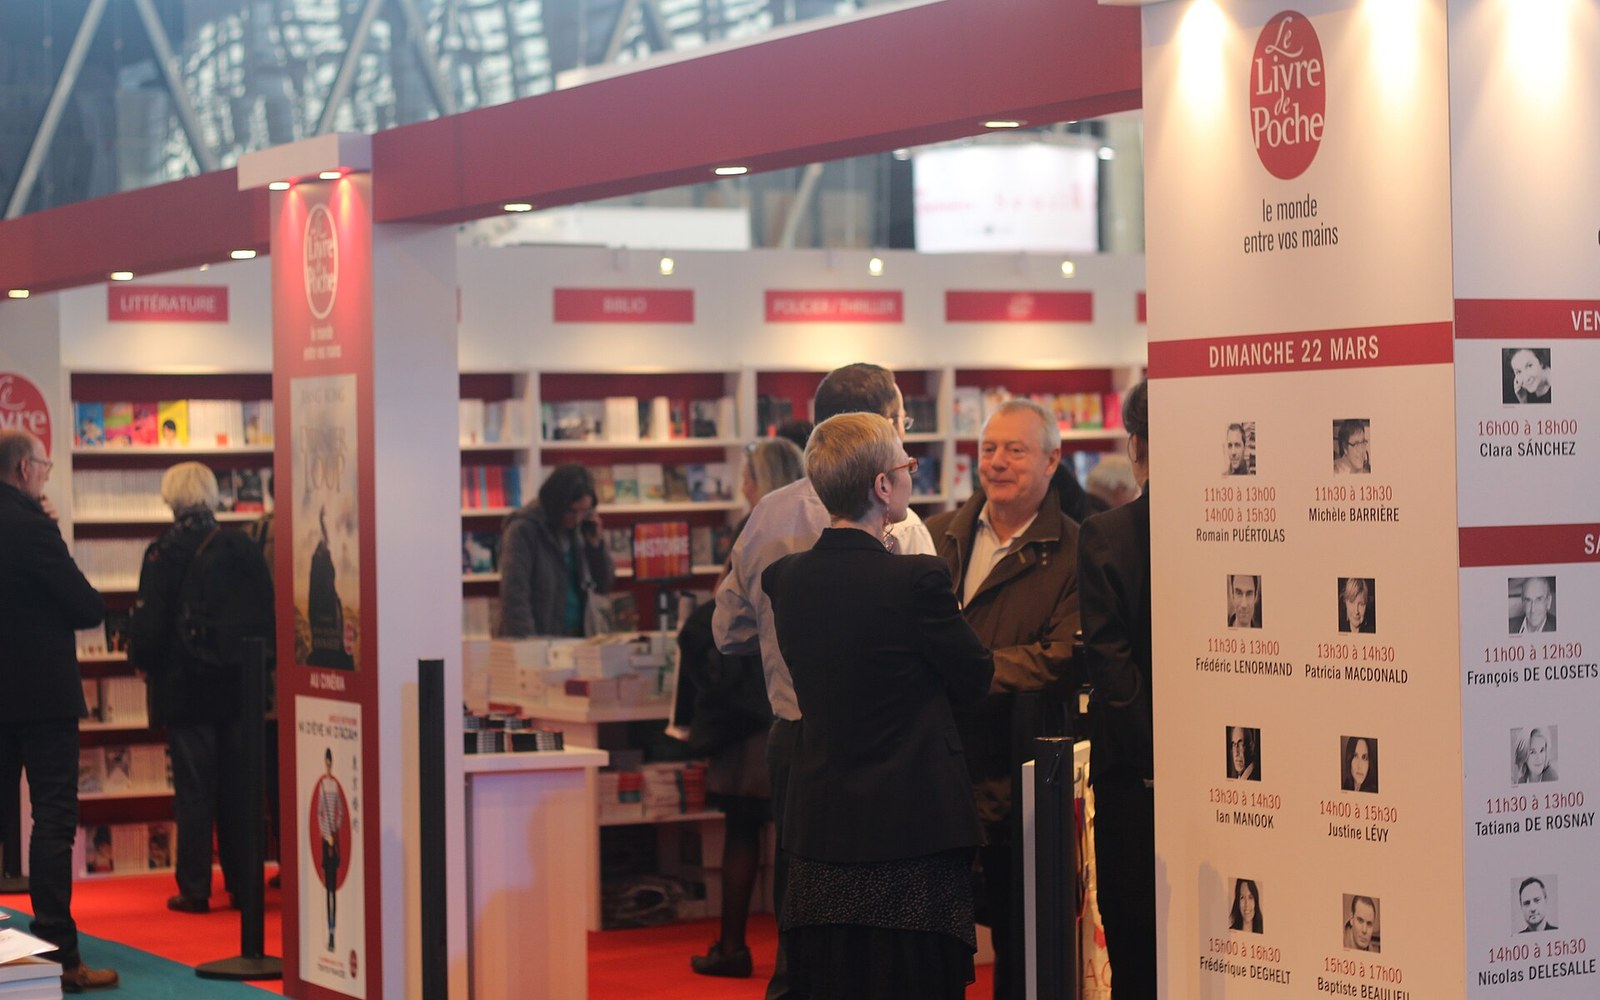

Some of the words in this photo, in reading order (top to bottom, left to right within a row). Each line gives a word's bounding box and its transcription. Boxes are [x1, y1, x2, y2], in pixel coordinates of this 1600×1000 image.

[1265, 16, 1304, 58] Le
[1255, 54, 1322, 96] Livre
[1274, 87, 1291, 116] de
[1251, 102, 1325, 150] Poche
[1262, 198, 1273, 223] le
[1276, 193, 1318, 221] monde
[1243, 230, 1274, 254] entre
[1277, 230, 1298, 251] vos
[1301, 223, 1339, 248] mains
[120, 293, 217, 314] LITTÉRATURE
[1209, 340, 1295, 369] DIMANCHE
[1301, 338, 1322, 363] 22
[1330, 334, 1379, 361] MARS
[1478, 420, 1519, 436] 16h00
[1523, 420, 1531, 436] à
[1537, 419, 1578, 435] 18h00
[1479, 442, 1513, 458] Clara
[1517, 437, 1576, 457] SÁNCHEZ
[1204, 487, 1234, 502] 11h30
[1236, 486, 1242, 502] à
[1246, 486, 1276, 502] 13h00
[1314, 486, 1349, 502] 11h30
[1348, 486, 1357, 502] à
[1360, 485, 1393, 502] 13h30
[1205, 507, 1234, 523] 14h00
[1236, 507, 1243, 523] à
[1246, 507, 1277, 523] 15h30
[1308, 507, 1346, 522] Michèle
[1349, 504, 1400, 522] BARRIÈRE
[1196, 527, 1230, 542] Romain
[1232, 526, 1286, 543] PUÉRTOLAS
[1207, 637, 1238, 655] 11h30
[1240, 639, 1246, 655] à
[1249, 639, 1280, 657] 13h00
[1317, 643, 1349, 660] 13h30
[1351, 644, 1358, 661] à
[1362, 645, 1395, 663] 14h30
[1484, 645, 1525, 663] 11h00
[1529, 645, 1537, 661] à
[1542, 642, 1582, 660] 12h30
[1195, 657, 1232, 673] Frédéric
[1234, 659, 1293, 677] LENORMAND
[1305, 663, 1341, 680] Patricia
[1344, 666, 1408, 684] MACDONALD
[1466, 668, 1520, 689] François
[1523, 666, 1540, 682] DE
[1544, 663, 1599, 681] CLOSETS
[1209, 788, 1239, 806] 13h30
[1241, 791, 1248, 807] à
[1251, 792, 1281, 810] 14h30
[1486, 795, 1527, 814] 11h30
[1531, 795, 1539, 811] à
[1544, 791, 1584, 810] 13h00
[1216, 809, 1230, 824] Ian
[1232, 810, 1275, 830] MANOOK
[1320, 800, 1352, 818] 14h00
[1354, 803, 1361, 819] à
[1364, 804, 1398, 824] 15h30
[1327, 821, 1363, 842] Justine
[1364, 822, 1390, 844] LÉVY
[1474, 820, 1520, 837] Tatiana
[1525, 816, 1542, 832] DE
[1546, 811, 1595, 830] ROSNAY
[1209, 937, 1239, 956] 15h00
[1241, 945, 1247, 958] à
[1250, 944, 1281, 964] 16h30
[1488, 944, 1530, 964] 14h00
[1533, 943, 1541, 959] à
[1546, 937, 1586, 958] 15h30
[1199, 955, 1247, 978] Frédérique
[1249, 964, 1291, 985] DEGHELT
[1324, 956, 1356, 977] 15h30
[1359, 962, 1366, 978] à
[1369, 964, 1403, 985] 17h00
[1478, 968, 1524, 986] Nicolas
[1528, 958, 1596, 981] DELESALLE
[1317, 976, 1358, 997] Baptiste
